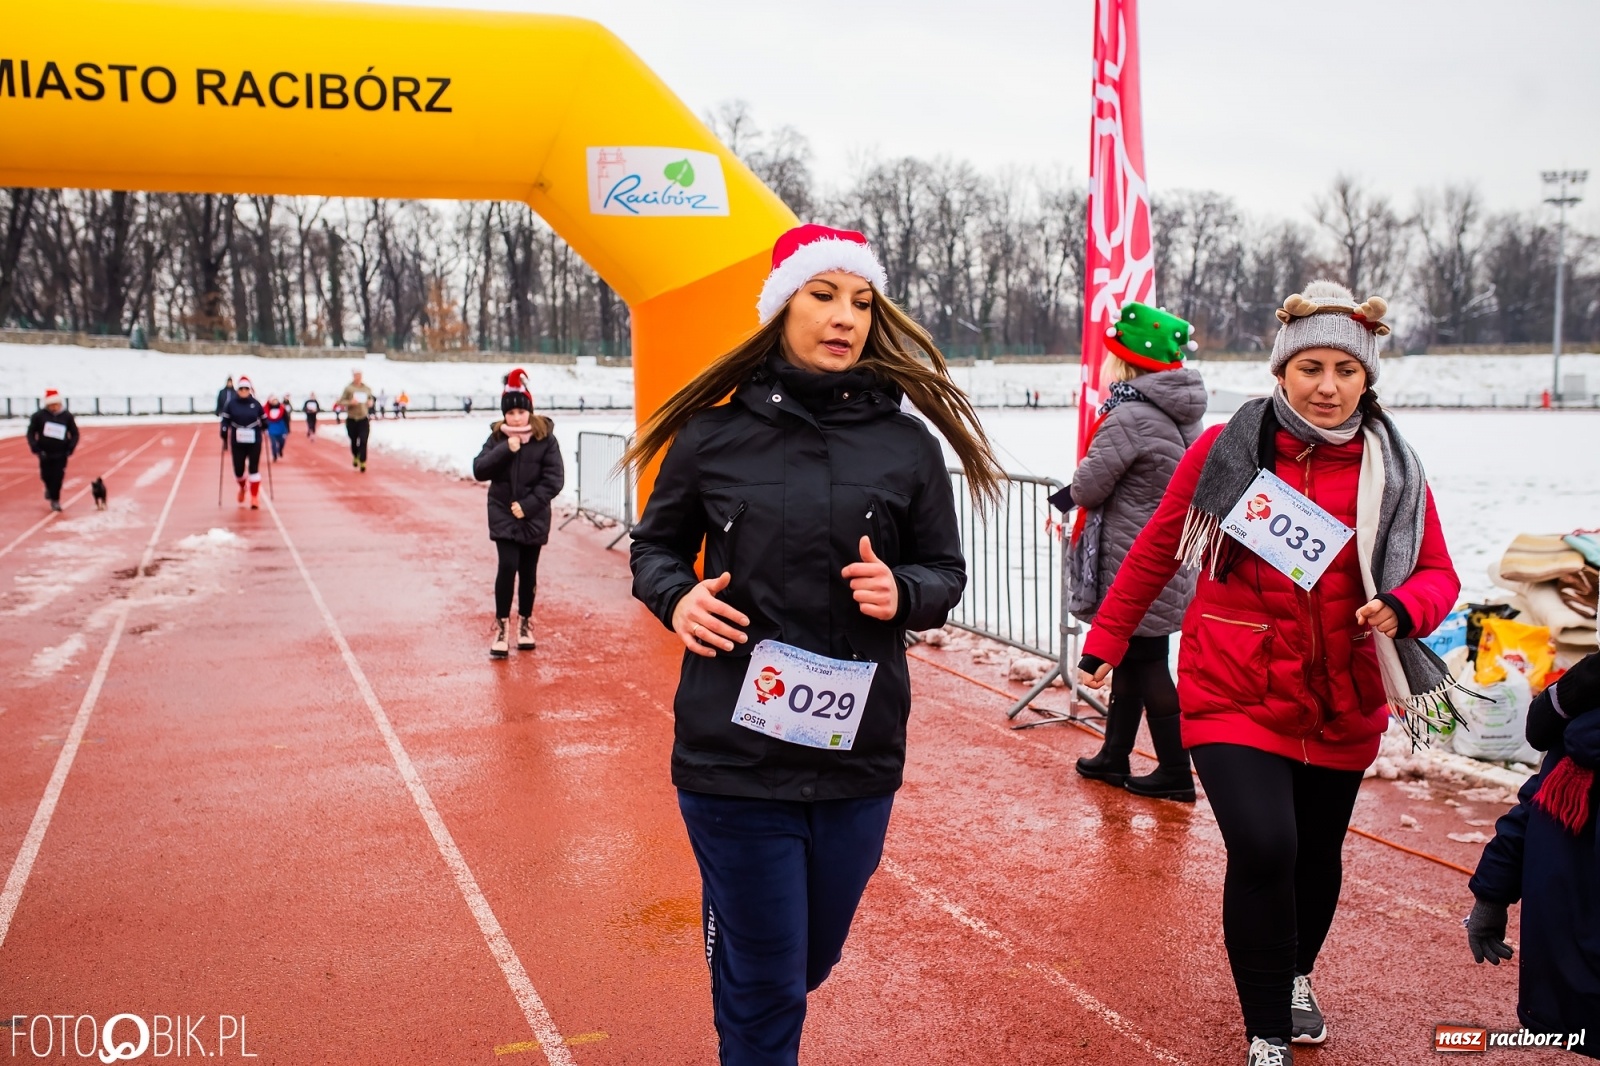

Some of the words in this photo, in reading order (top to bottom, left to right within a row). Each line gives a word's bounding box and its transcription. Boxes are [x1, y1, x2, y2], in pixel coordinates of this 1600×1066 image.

[196, 66, 453, 113] RACIBÓRZ
[603, 174, 720, 214] Racibórz
[1269, 513, 1326, 563] 033
[788, 684, 856, 721] 029
